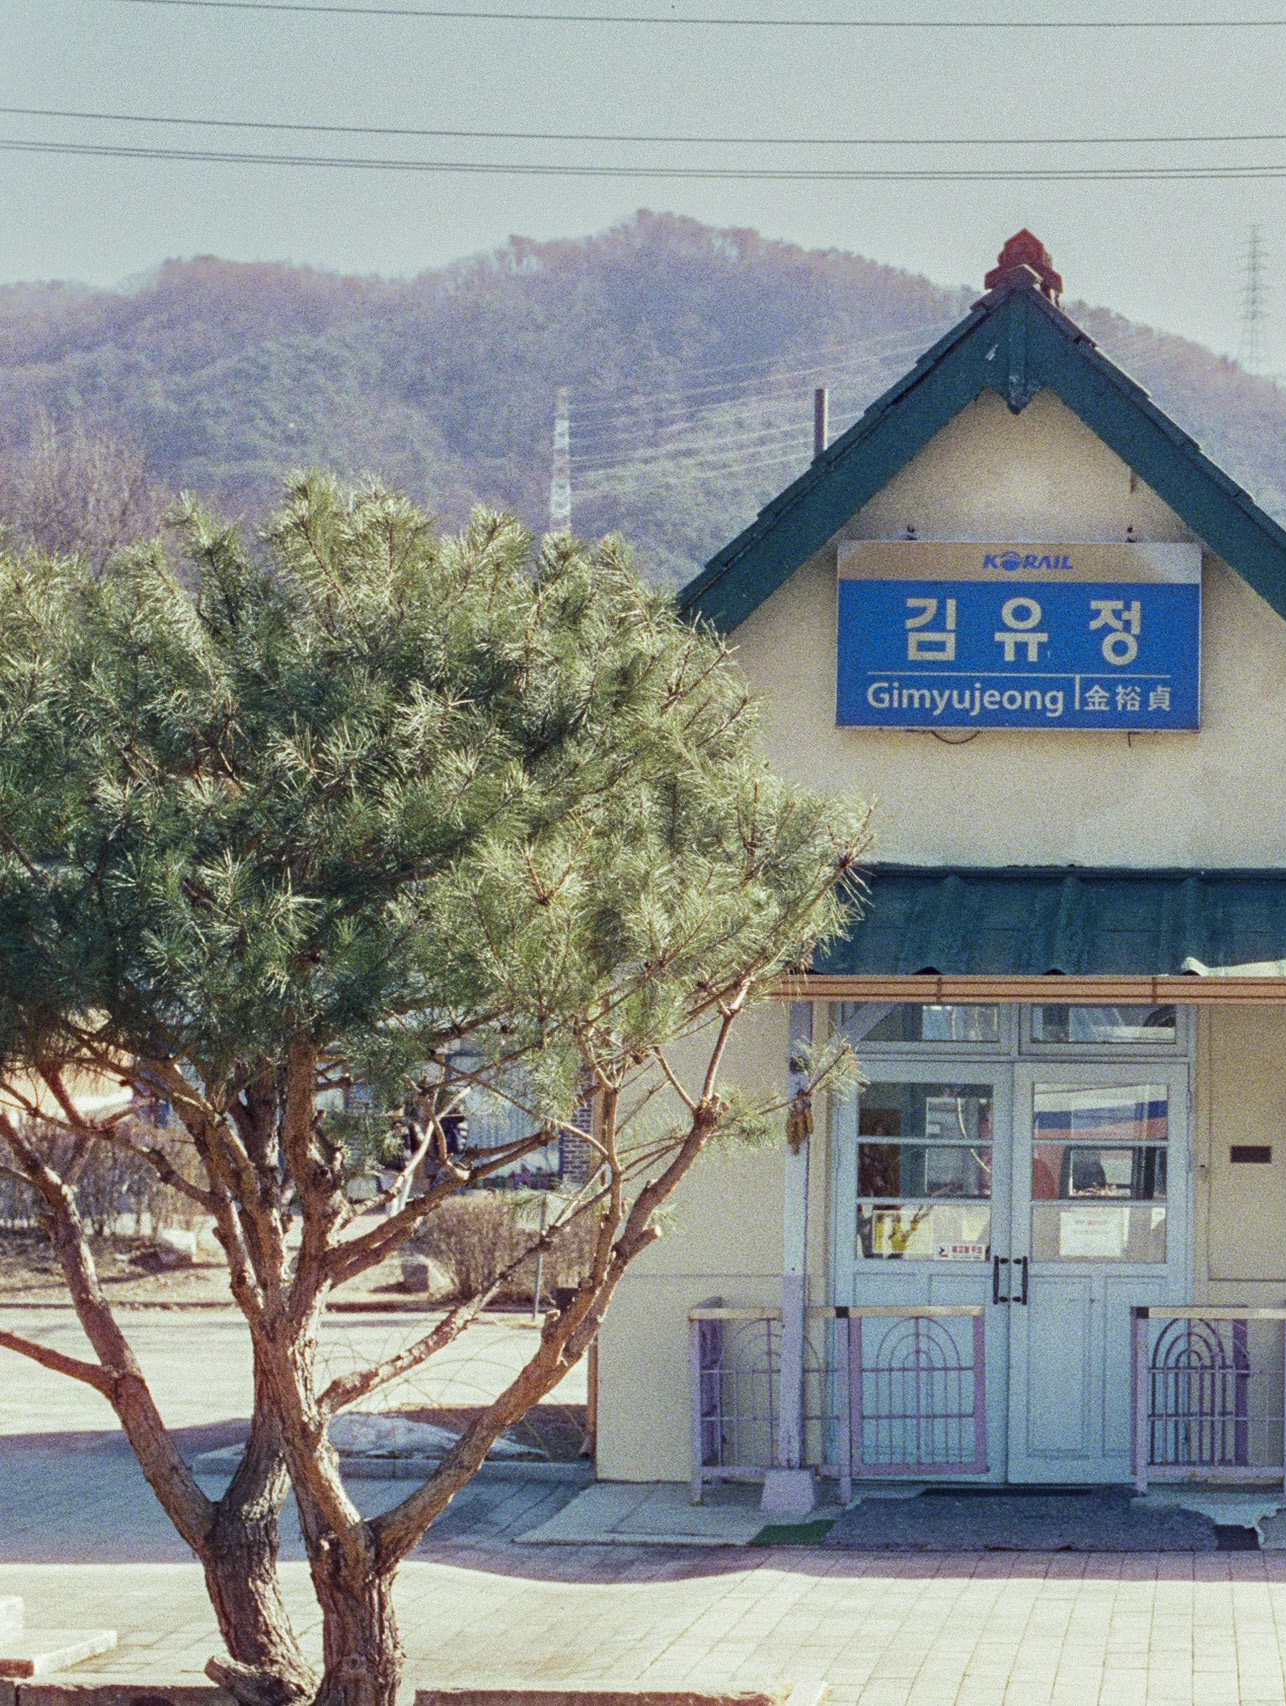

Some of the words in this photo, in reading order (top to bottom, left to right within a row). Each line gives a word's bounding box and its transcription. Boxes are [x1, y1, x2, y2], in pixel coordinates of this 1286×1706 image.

[983, 551, 1074, 571] KORAIL
[904, 597, 1142, 666] 김유정
[867, 682, 1065, 717] Gimyujeong
[1084, 685, 1171, 712] 金裕貞
